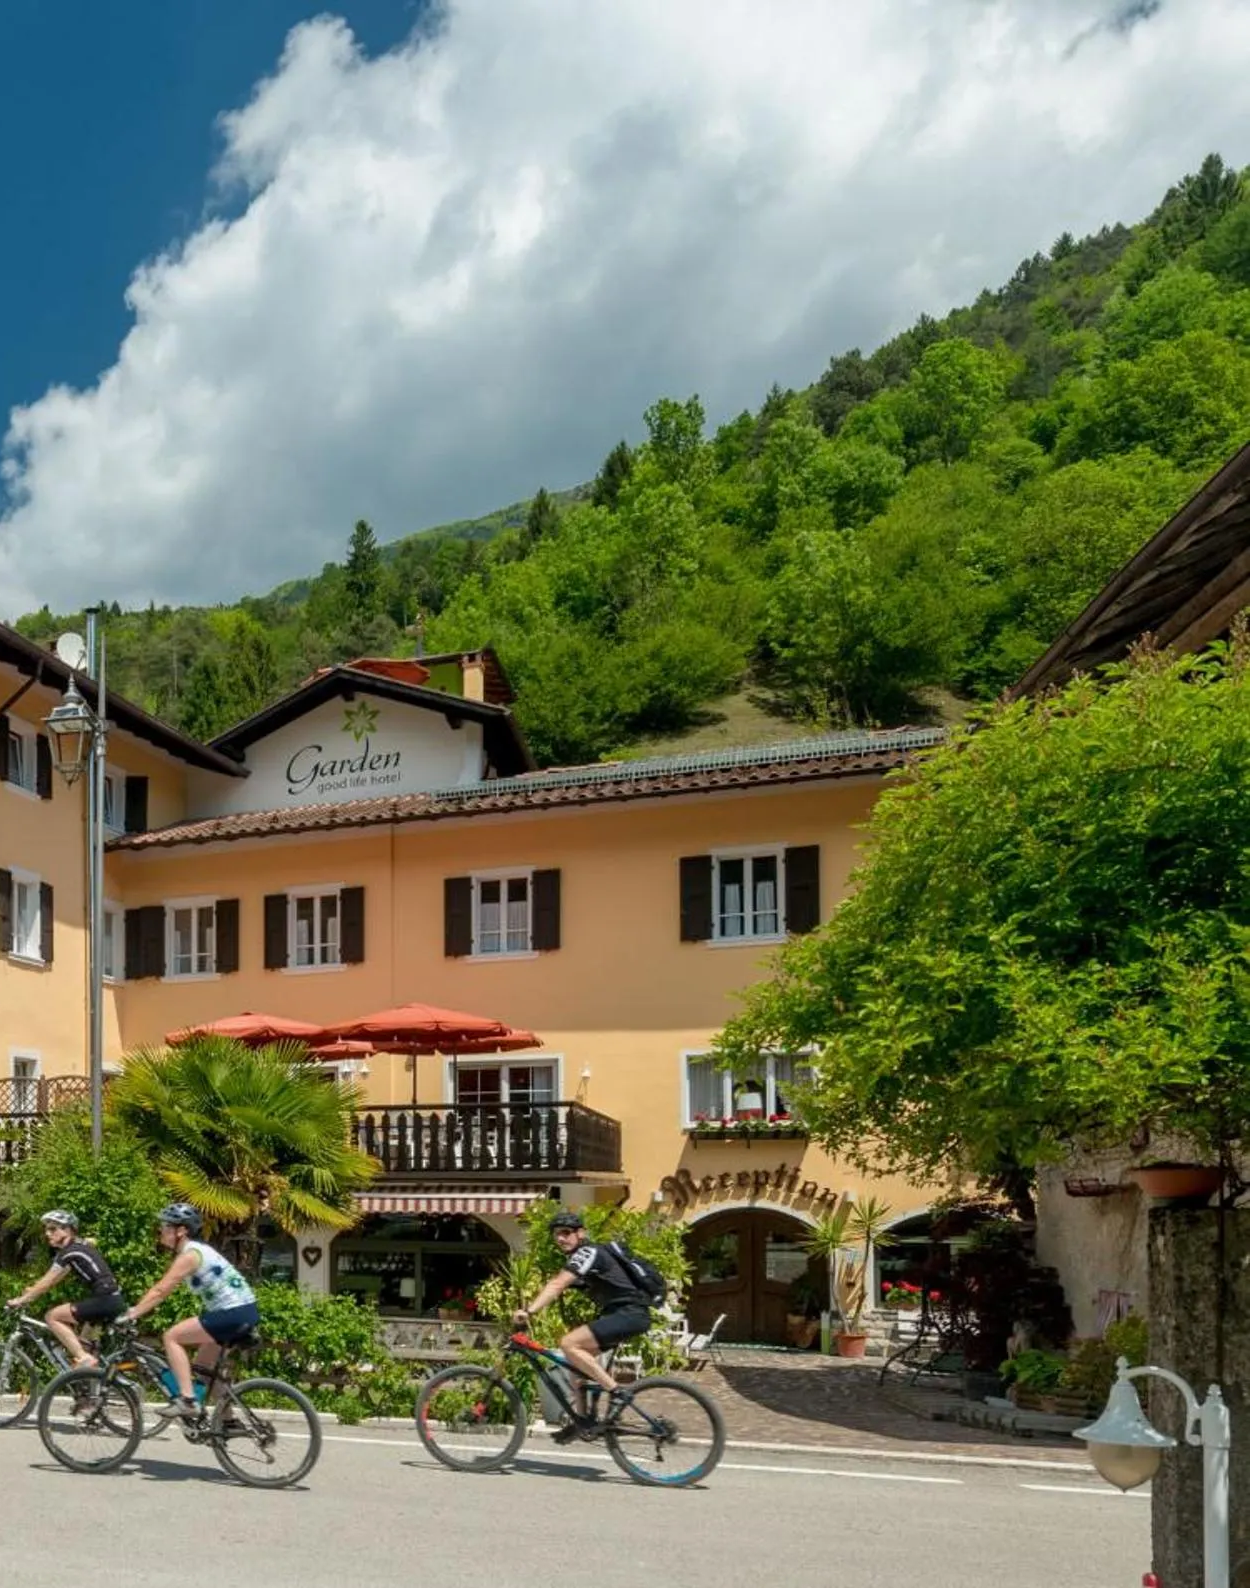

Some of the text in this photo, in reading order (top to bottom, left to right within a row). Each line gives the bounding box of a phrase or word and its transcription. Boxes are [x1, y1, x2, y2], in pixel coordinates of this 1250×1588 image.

[286, 736, 401, 795] Garden
[317, 771, 401, 794] good life hotel
[660, 1162, 839, 1209] Reception
